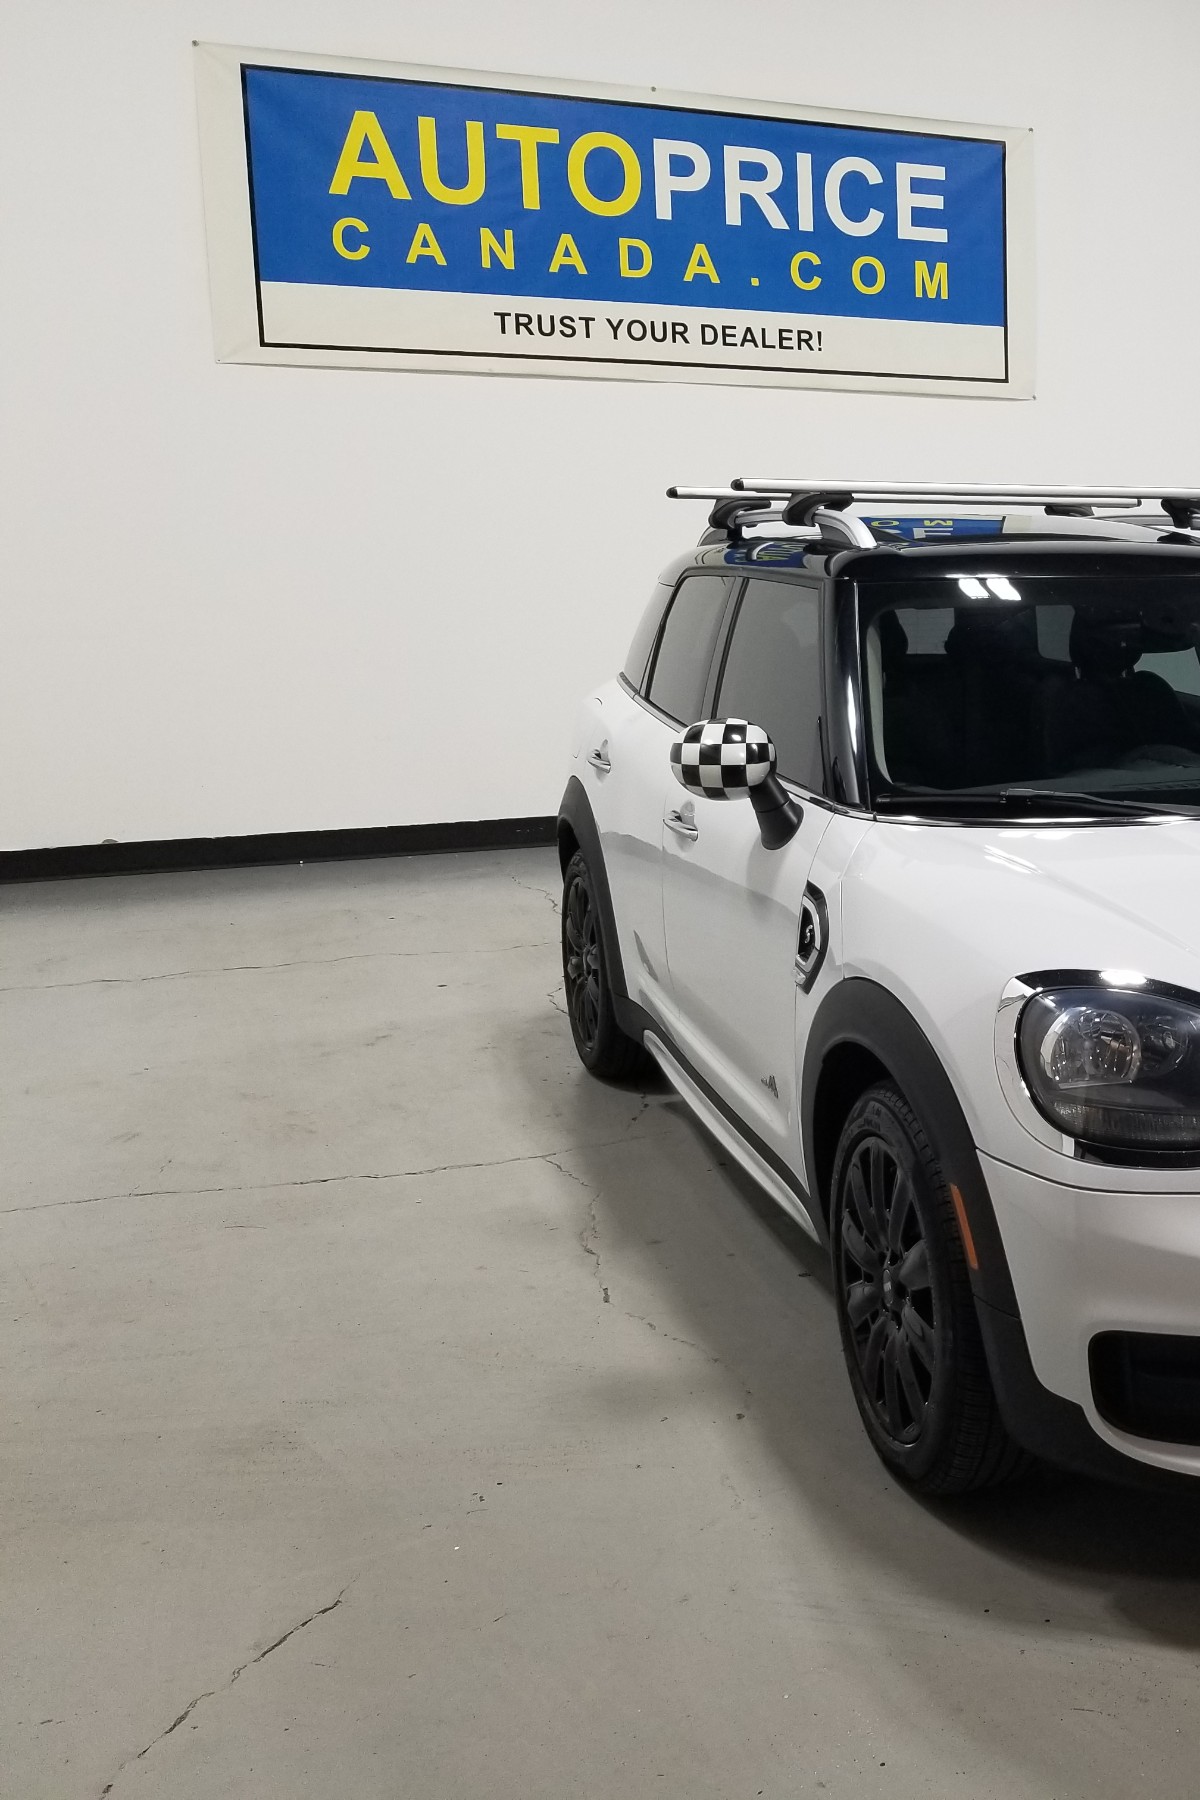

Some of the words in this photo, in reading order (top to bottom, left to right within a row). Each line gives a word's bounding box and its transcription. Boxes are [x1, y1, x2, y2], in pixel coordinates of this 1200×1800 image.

[330, 110, 948, 243] AUTOPRICE
[333, 218, 947, 298] CANADA.COM
[493, 311, 596, 339] TRUST
[605, 318, 690, 344] YOUR
[700, 323, 823, 352] DEALER!
